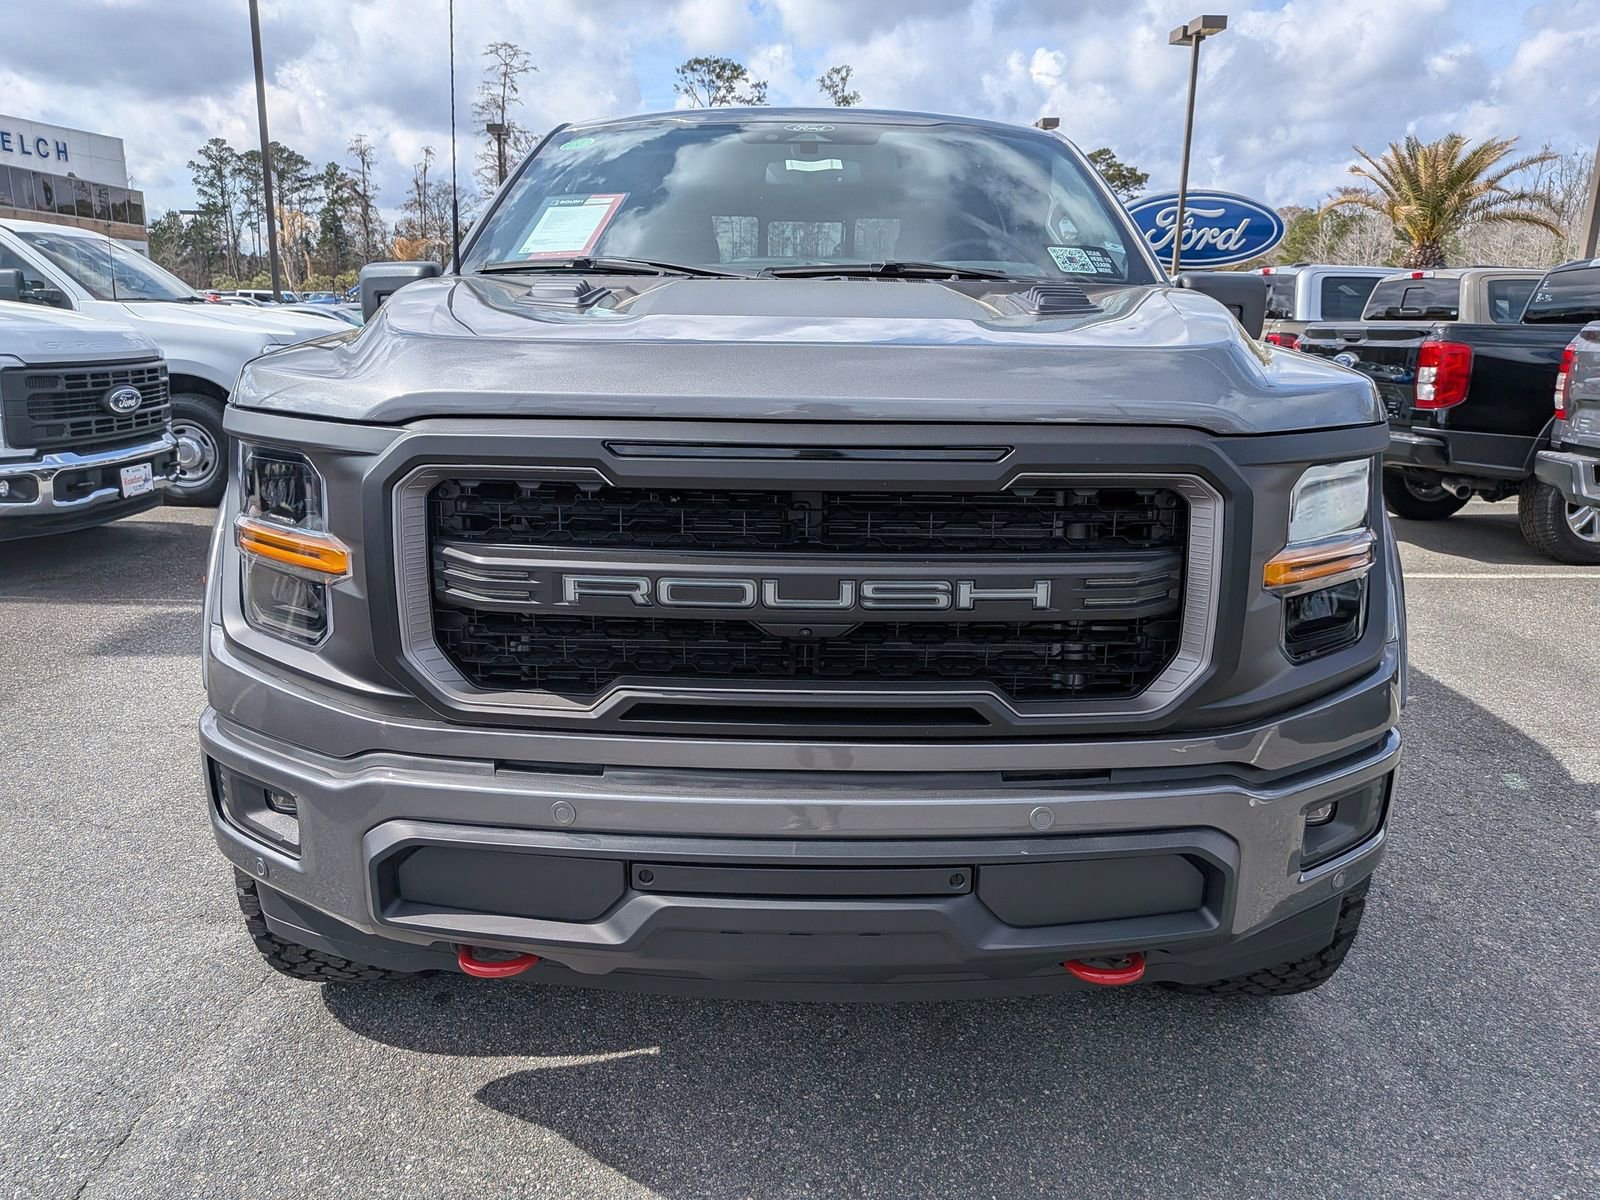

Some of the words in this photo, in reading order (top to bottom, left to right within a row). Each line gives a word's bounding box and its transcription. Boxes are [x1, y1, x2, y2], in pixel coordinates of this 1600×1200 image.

[1145, 206, 1251, 251] Ford
[118, 394, 136, 408] Ford
[560, 574, 1052, 611] ROUSH
